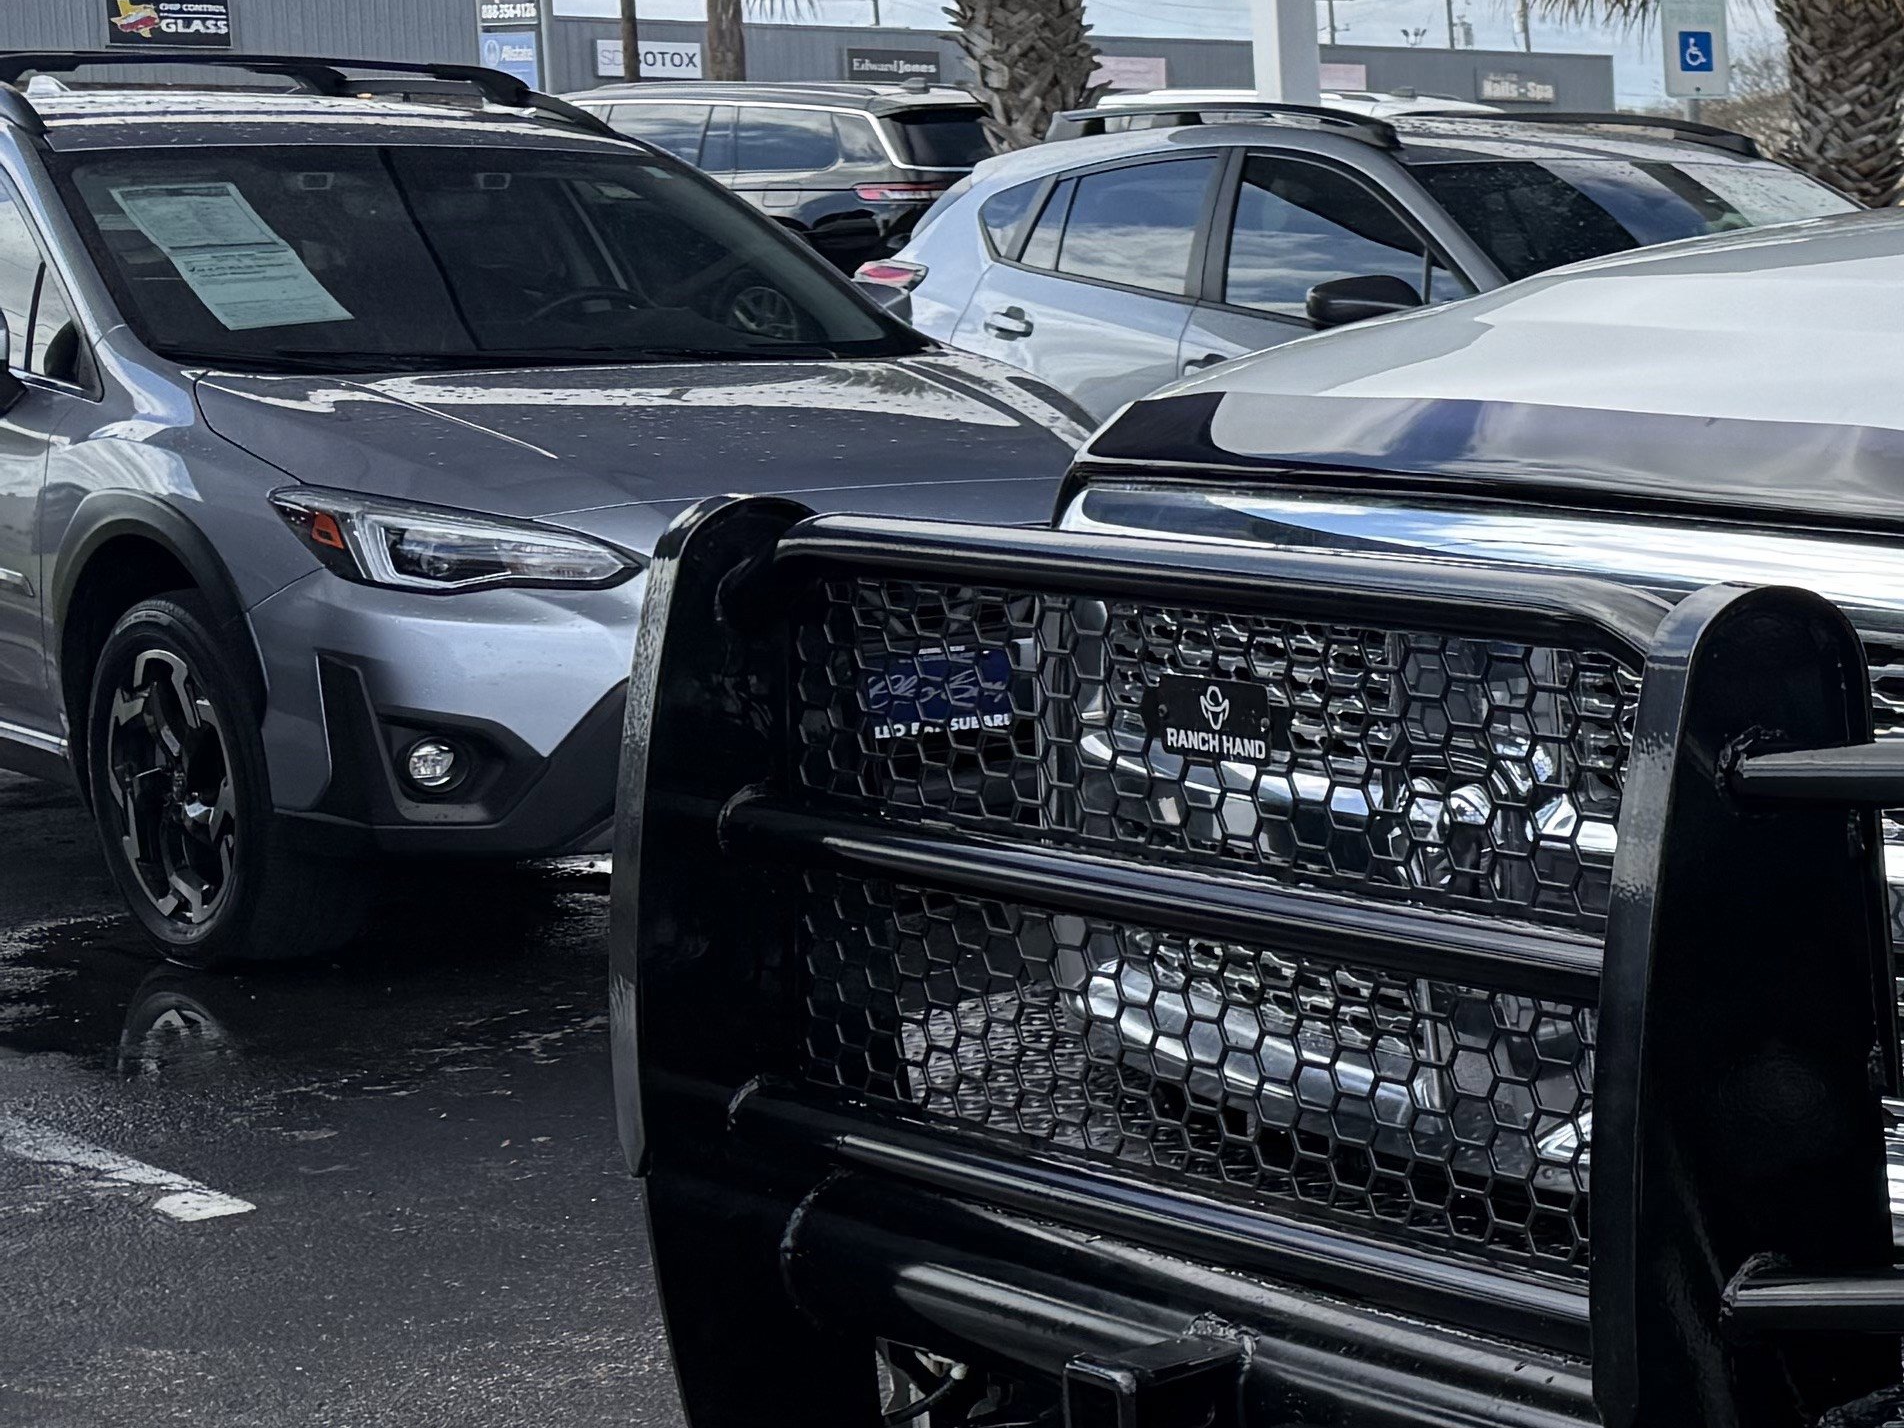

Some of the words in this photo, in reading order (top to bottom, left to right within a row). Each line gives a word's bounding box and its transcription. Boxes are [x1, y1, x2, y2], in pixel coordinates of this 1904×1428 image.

[160, 19, 229, 34] GLASS
[639, 51, 698, 68] OTOX
[898, 60, 937, 74] Jones
[1166, 727, 1219, 753] RANCH
[1222, 735, 1266, 760] HAND
